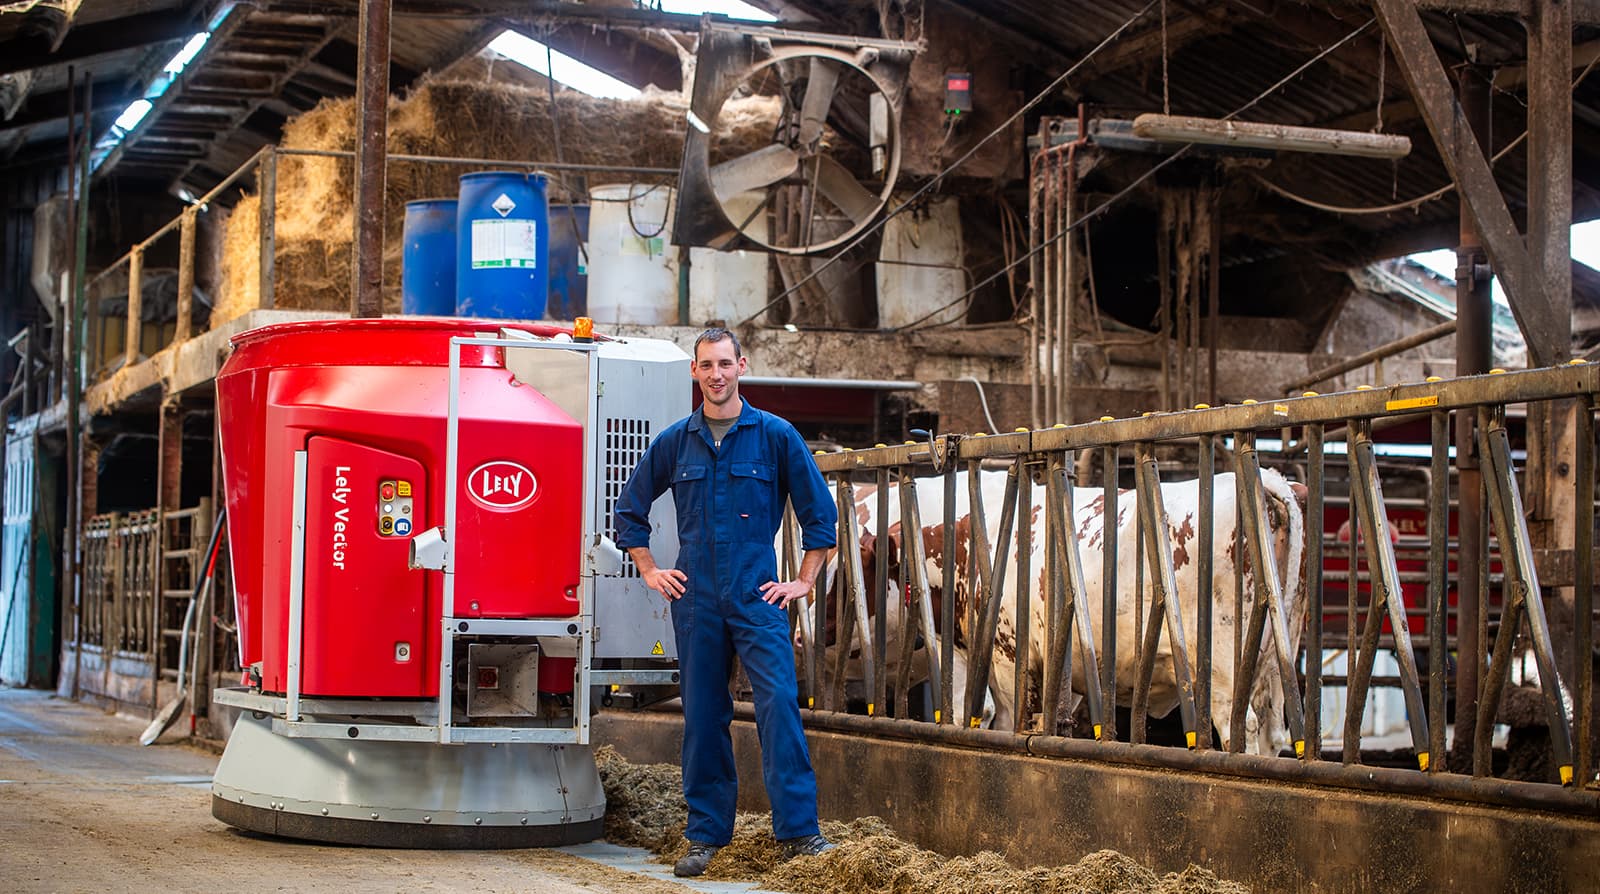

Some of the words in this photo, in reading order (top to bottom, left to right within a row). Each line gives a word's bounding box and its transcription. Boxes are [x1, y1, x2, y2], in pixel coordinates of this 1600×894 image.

[332, 466, 351, 504] Lely
[482, 469, 523, 498] LELY
[332, 508, 350, 570] Vector
